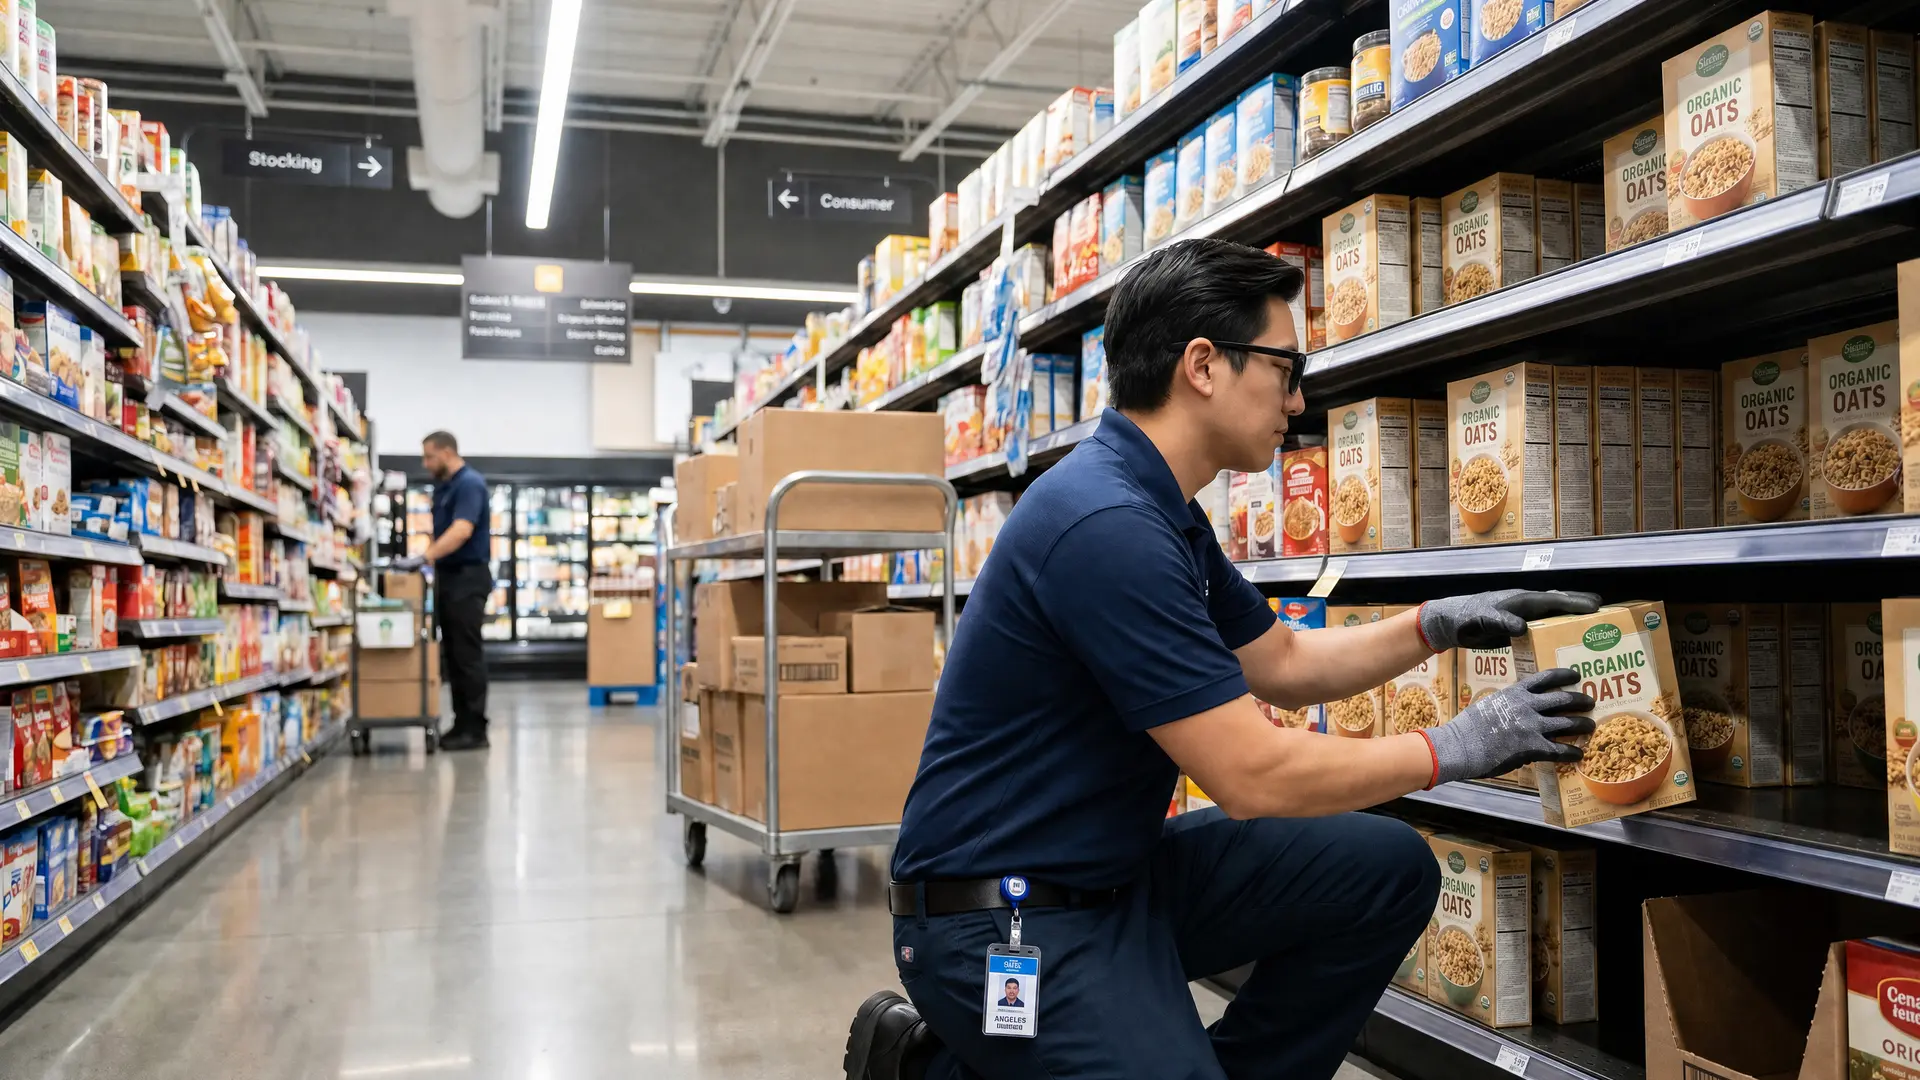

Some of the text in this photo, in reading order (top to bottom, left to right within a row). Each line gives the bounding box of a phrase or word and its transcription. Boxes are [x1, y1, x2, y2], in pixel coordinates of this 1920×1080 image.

[1687, 77, 1742, 115] ORGANIC
[1691, 98, 1739, 137] OATS
[249, 151, 322, 174] Stocking
[1626, 170, 1666, 204] OATS
[820, 193, 895, 211] Consumer
[1453, 212, 1489, 237] ORGANIC
[1334, 233, 1362, 255] ORGANIC
[1456, 229, 1487, 255] OATS
[1336, 247, 1360, 272] OATS
[1829, 364, 1891, 390] ORGANIC
[1741, 385, 1795, 409] ORGANIC
[1833, 384, 1886, 414] OATS
[1462, 404, 1500, 426] ORGANIC
[1745, 405, 1790, 431] OATS
[1464, 421, 1497, 446] OATS
[1339, 447, 1363, 468] OATS
[1475, 655, 1508, 677] OATS
[1679, 656, 1719, 679] OATS
[1582, 671, 1642, 703] OATS
[1443, 892, 1472, 919] OATS
[994, 1015, 1026, 1024] ANGELES
